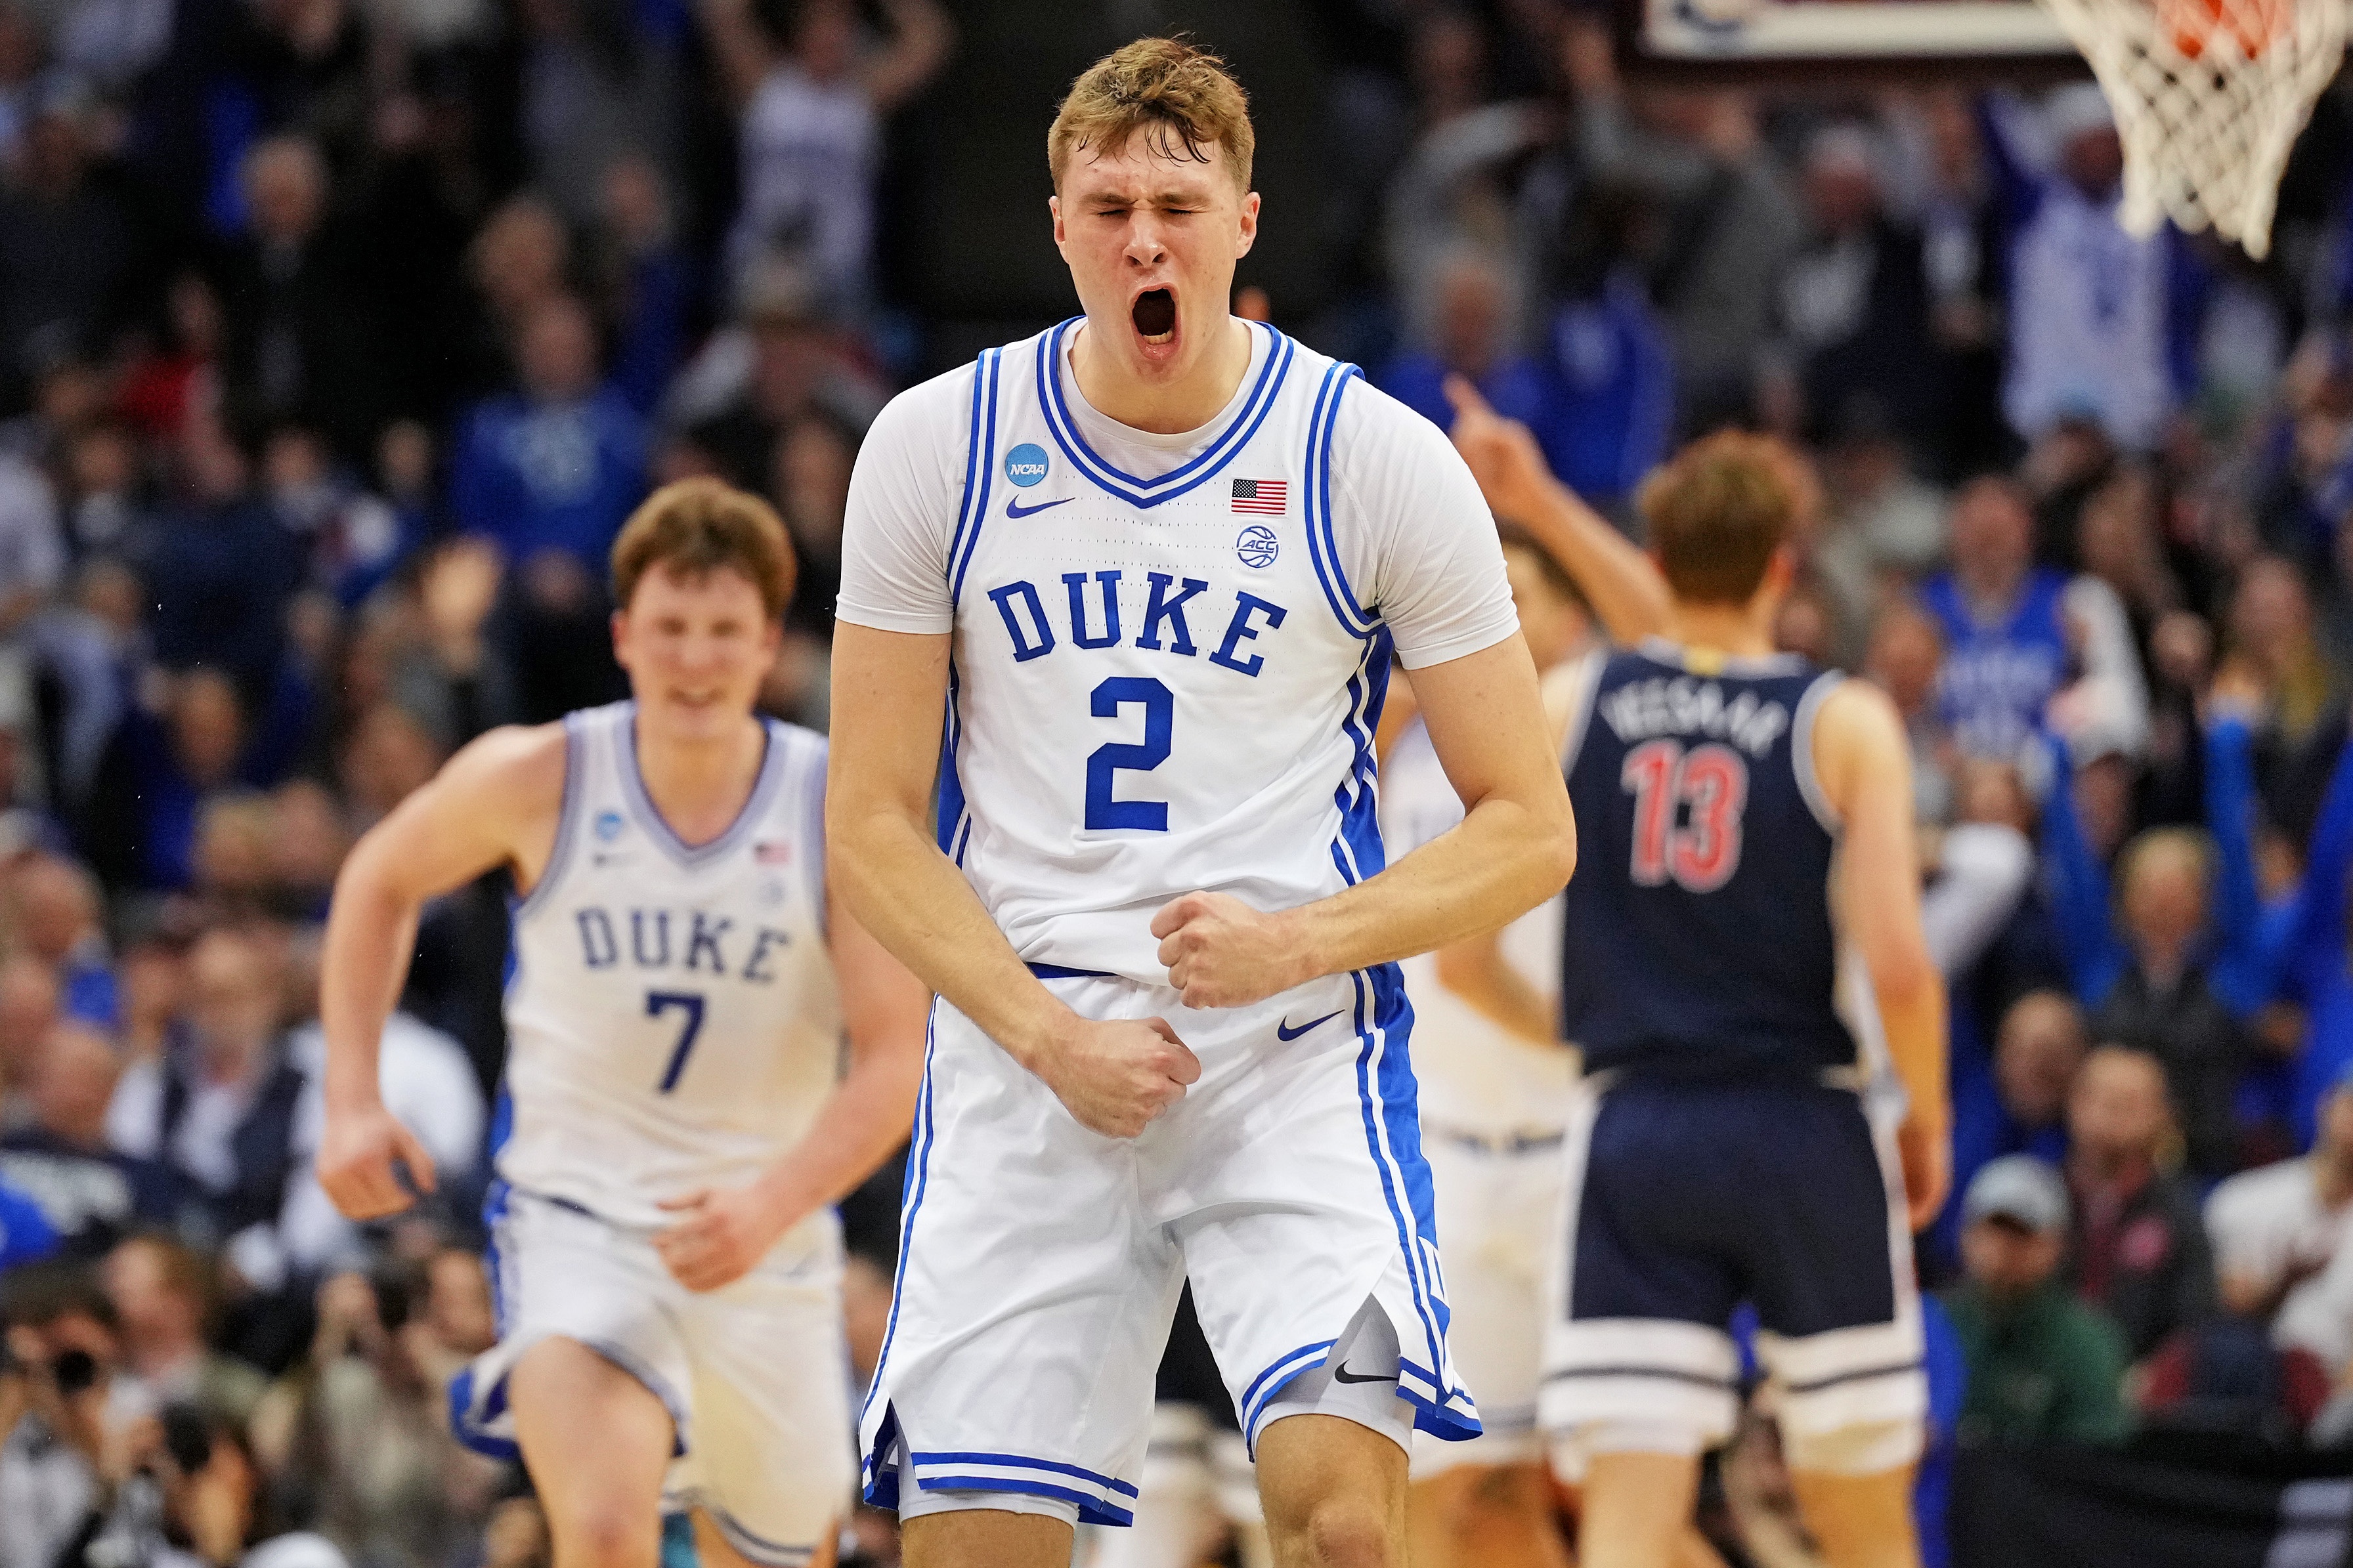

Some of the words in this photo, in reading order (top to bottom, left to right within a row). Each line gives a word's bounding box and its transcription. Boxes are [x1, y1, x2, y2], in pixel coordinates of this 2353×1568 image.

[1010, 465, 1045, 475] NCAA
[1242, 540, 1276, 553] ACC
[987, 570, 1287, 677] DUKE
[1085, 677, 1174, 831] 2
[1622, 740, 1749, 891] 13
[576, 906, 790, 982] DUKE
[646, 992, 706, 1093] 7
